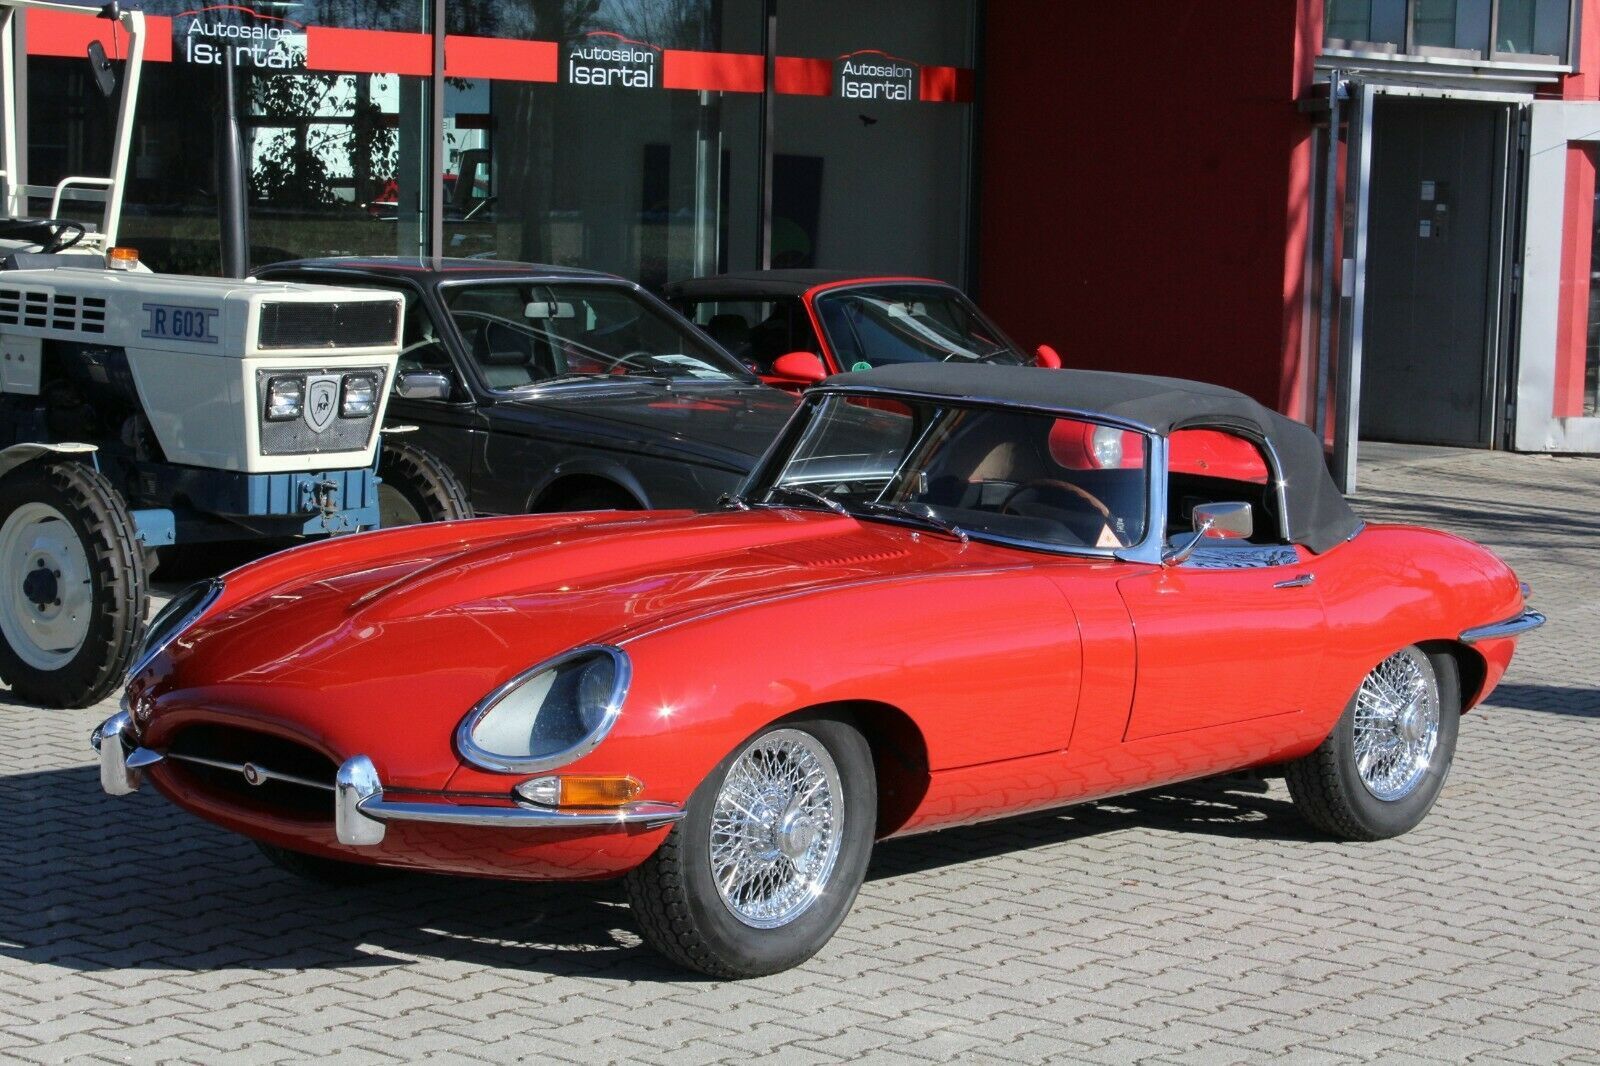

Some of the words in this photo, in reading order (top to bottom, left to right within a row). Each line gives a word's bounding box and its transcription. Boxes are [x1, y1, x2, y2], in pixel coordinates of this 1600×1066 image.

[570, 44, 654, 63] Autosalon
[569, 59, 654, 88] Isartal
[842, 60, 912, 78] Autosalon
[841, 75, 912, 101] Isartal
[154, 308, 166, 335] R
[172, 309, 204, 338] 603
